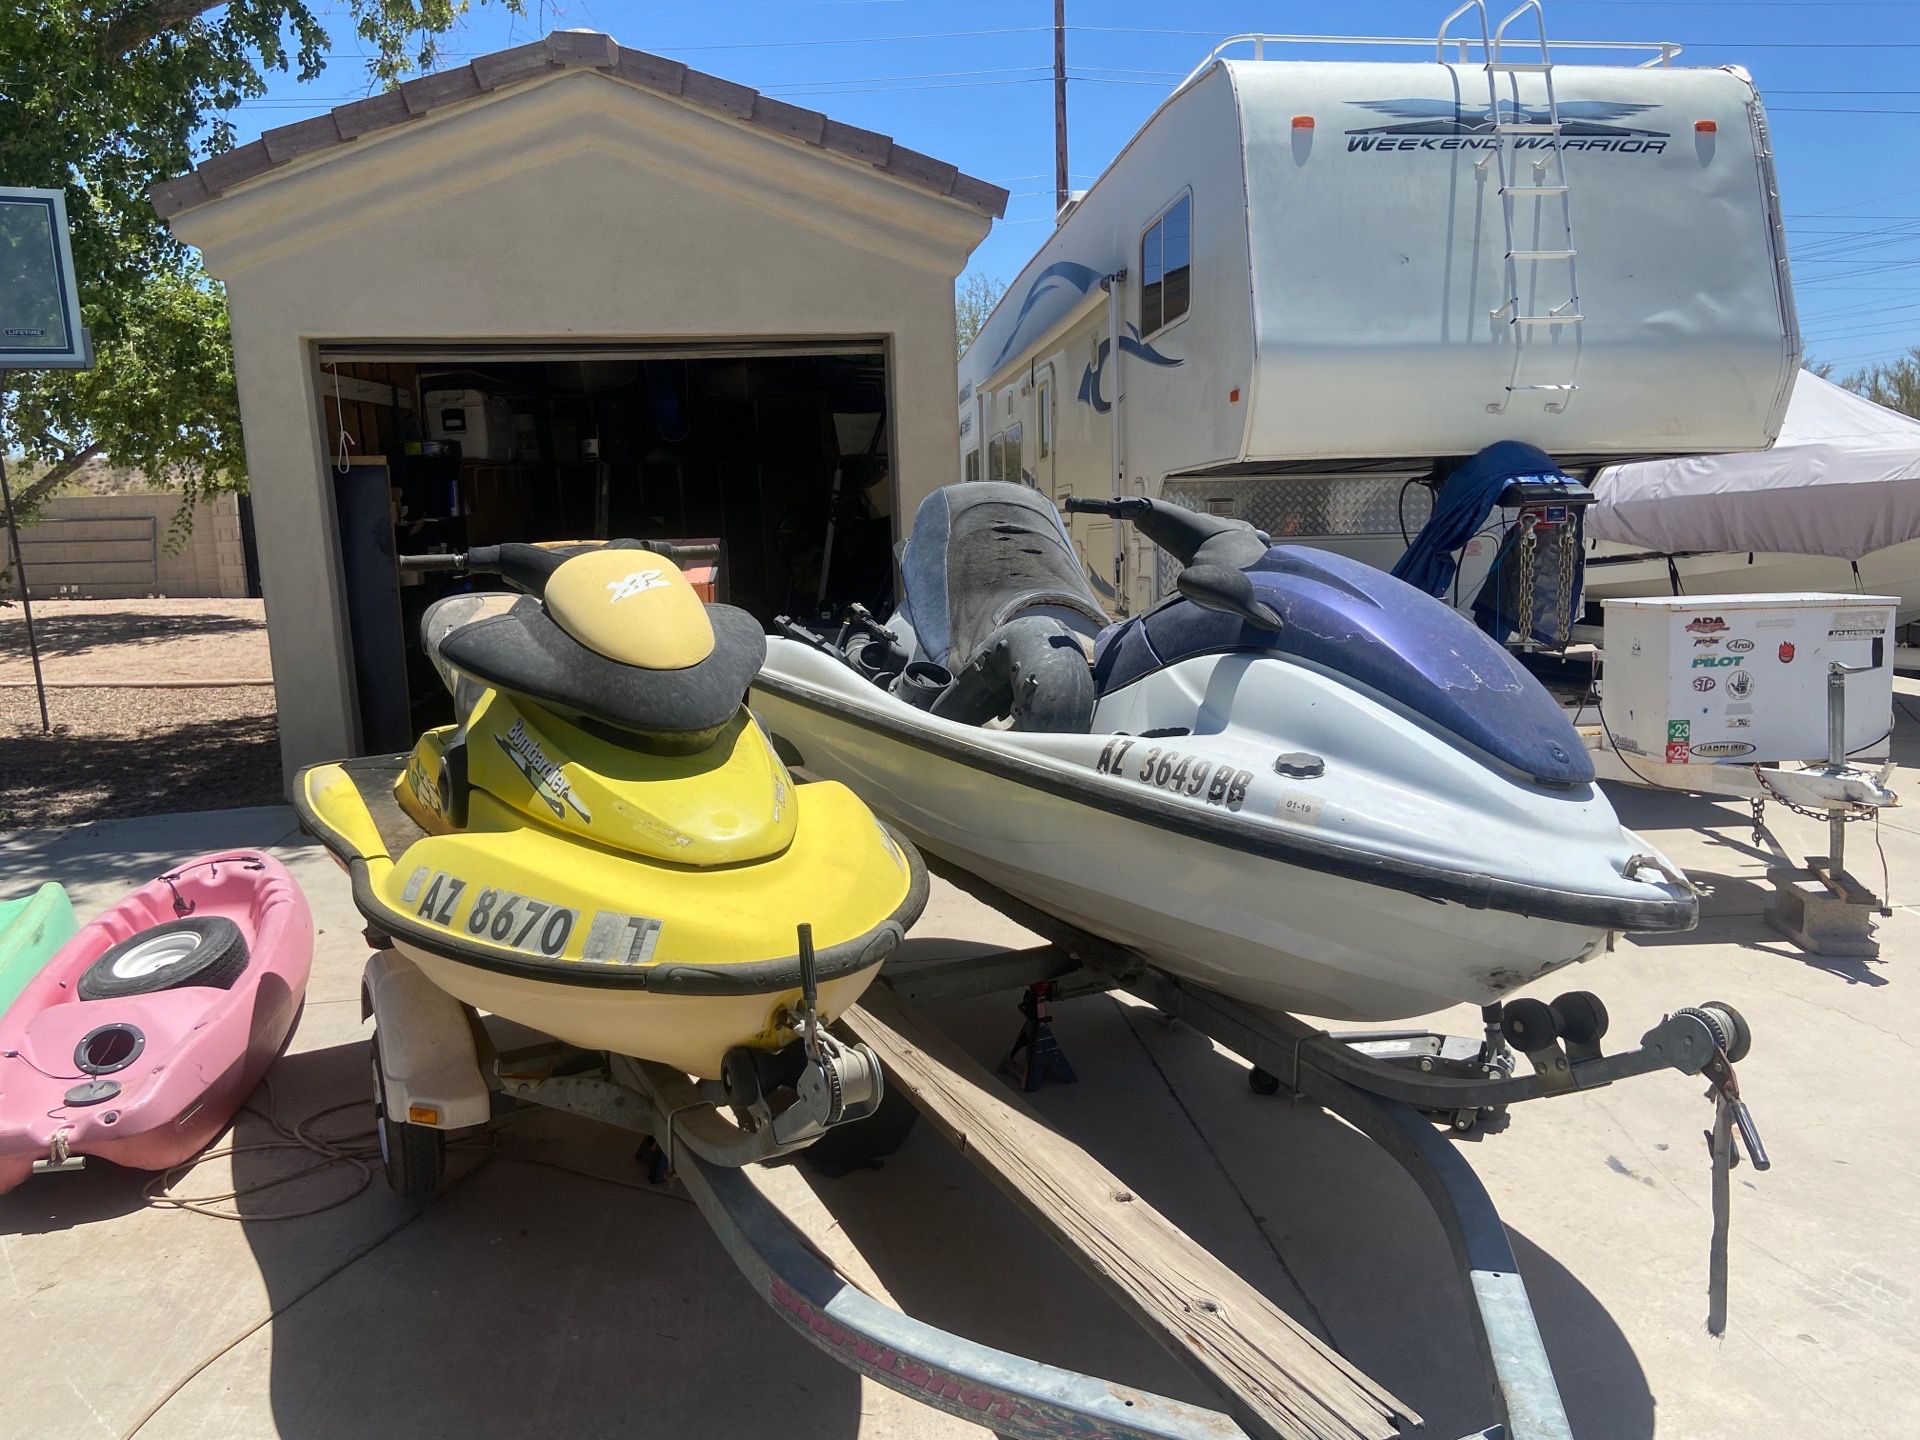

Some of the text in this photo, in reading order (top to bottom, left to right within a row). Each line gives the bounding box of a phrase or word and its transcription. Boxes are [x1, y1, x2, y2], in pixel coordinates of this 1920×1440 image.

[1347, 135, 1667, 155] WEEKEND WARRIOR
[1692, 656, 1744, 668] PILOT
[1694, 678, 1714, 690] STP
[1675, 724, 1689, 737] 23
[506, 718, 571, 798] Bombardier
[1674, 745, 1688, 759] 25
[1096, 739, 1135, 776] AZ
[1139, 747, 1211, 797] 3649
[1286, 800, 1311, 813] 01-19
[416, 874, 467, 926] AZ
[468, 887, 573, 956] 8670
